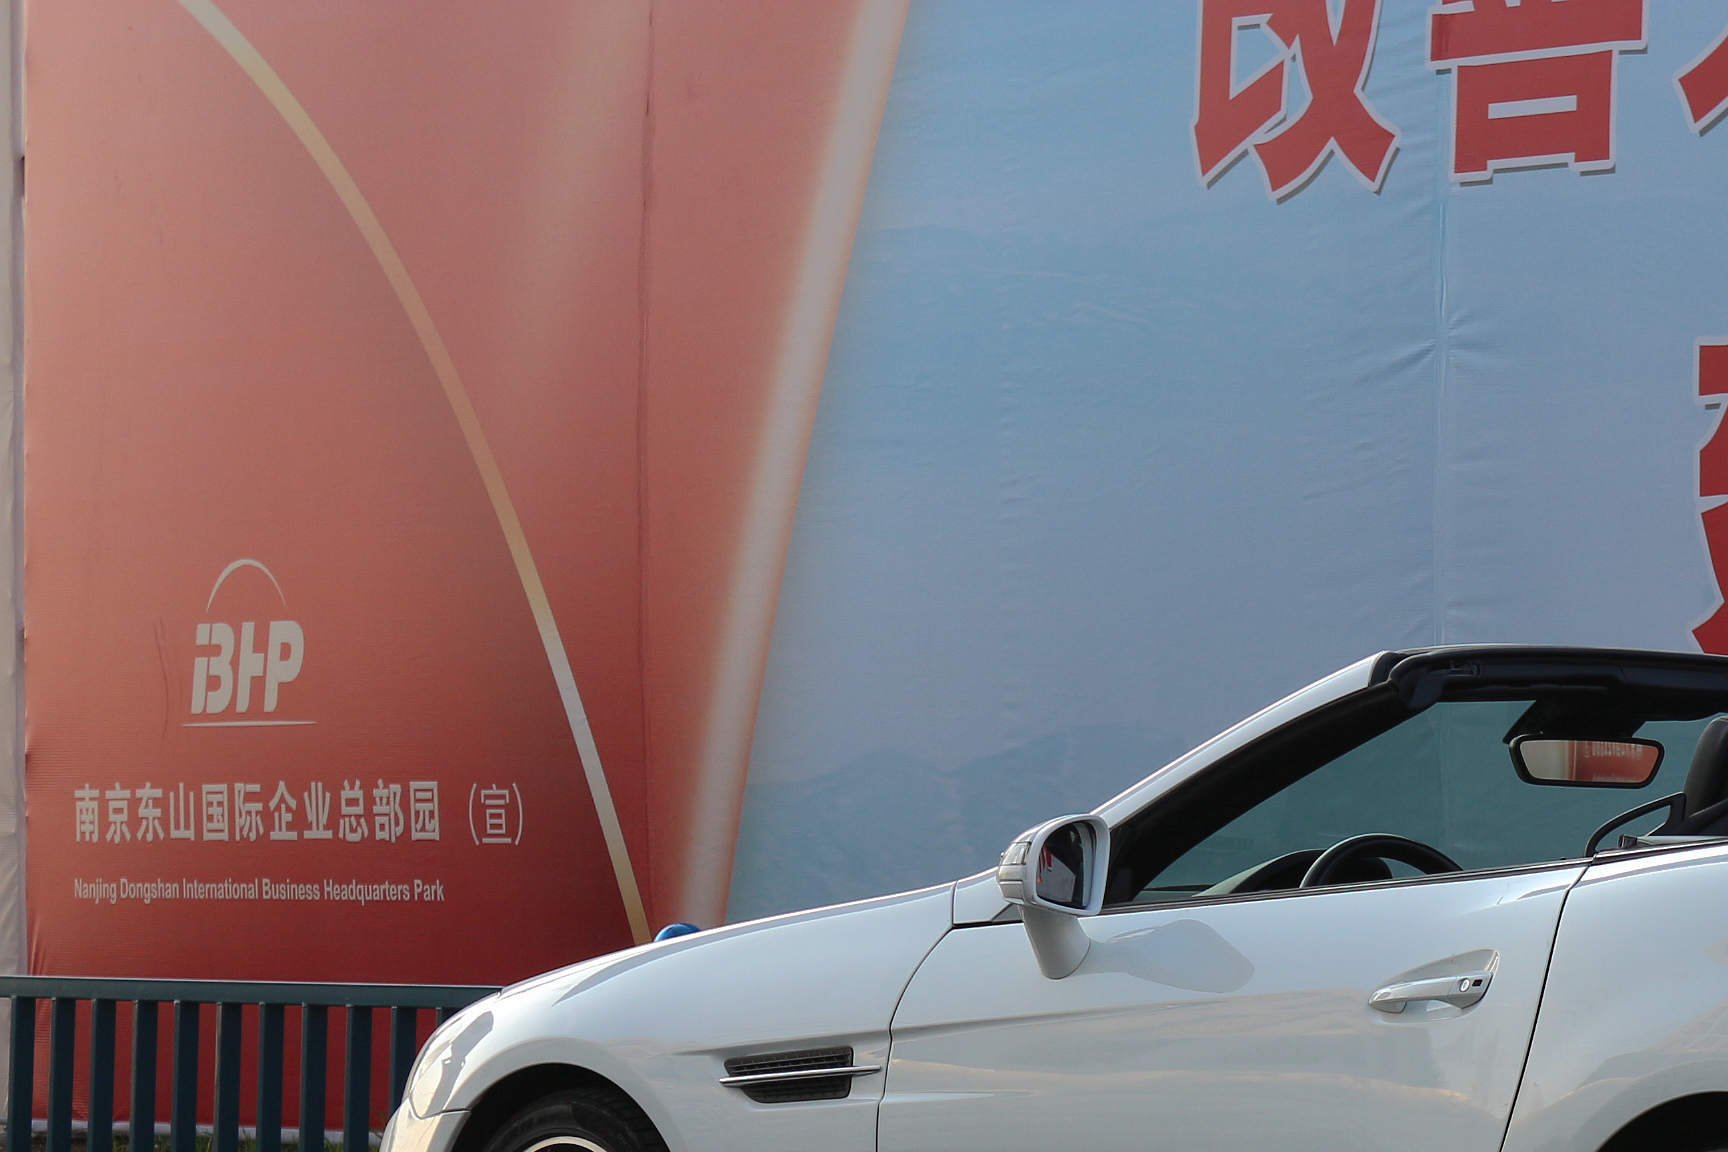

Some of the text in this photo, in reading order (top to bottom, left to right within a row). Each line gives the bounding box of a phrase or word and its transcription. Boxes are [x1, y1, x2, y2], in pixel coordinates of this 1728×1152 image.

[73, 779, 441, 843] 南京东山国际企业总部园
[74, 877, 444, 907] Nanjing Dongshan International Business Headquarters Park
